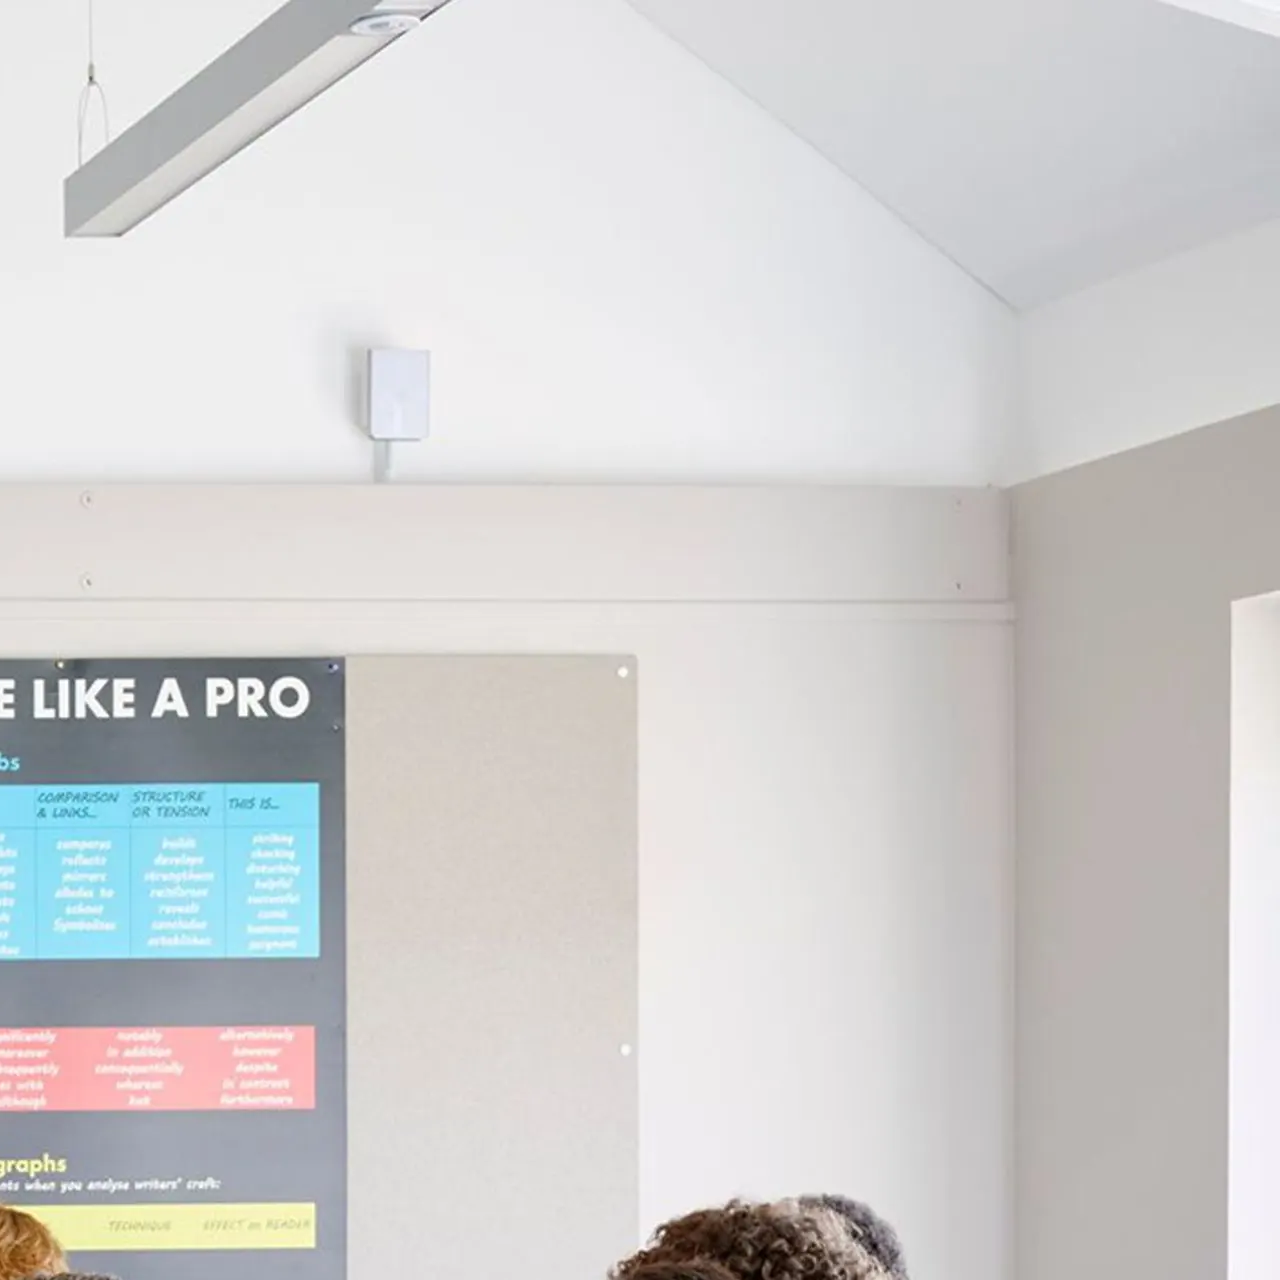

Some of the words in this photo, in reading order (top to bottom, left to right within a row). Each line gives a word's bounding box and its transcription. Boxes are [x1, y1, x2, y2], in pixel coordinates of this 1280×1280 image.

[33, 679, 135, 719] LIKE
[152, 679, 189, 718] A
[206, 677, 310, 718] PRO
[37, 791, 120, 804] COMPARISON
[133, 791, 206, 803] STRUCTURE
[228, 798, 256, 809] THIS
[37, 807, 47, 818] &
[133, 807, 151, 818] OR
[157, 806, 210, 818] TENSION
[25, 1180, 55, 1192] when
[61, 1180, 83, 1194] you
[88, 1179, 129, 1194] analyse
[187, 1178, 221, 1191] craft:
[109, 1221, 172, 1232] TECHNIQUE
